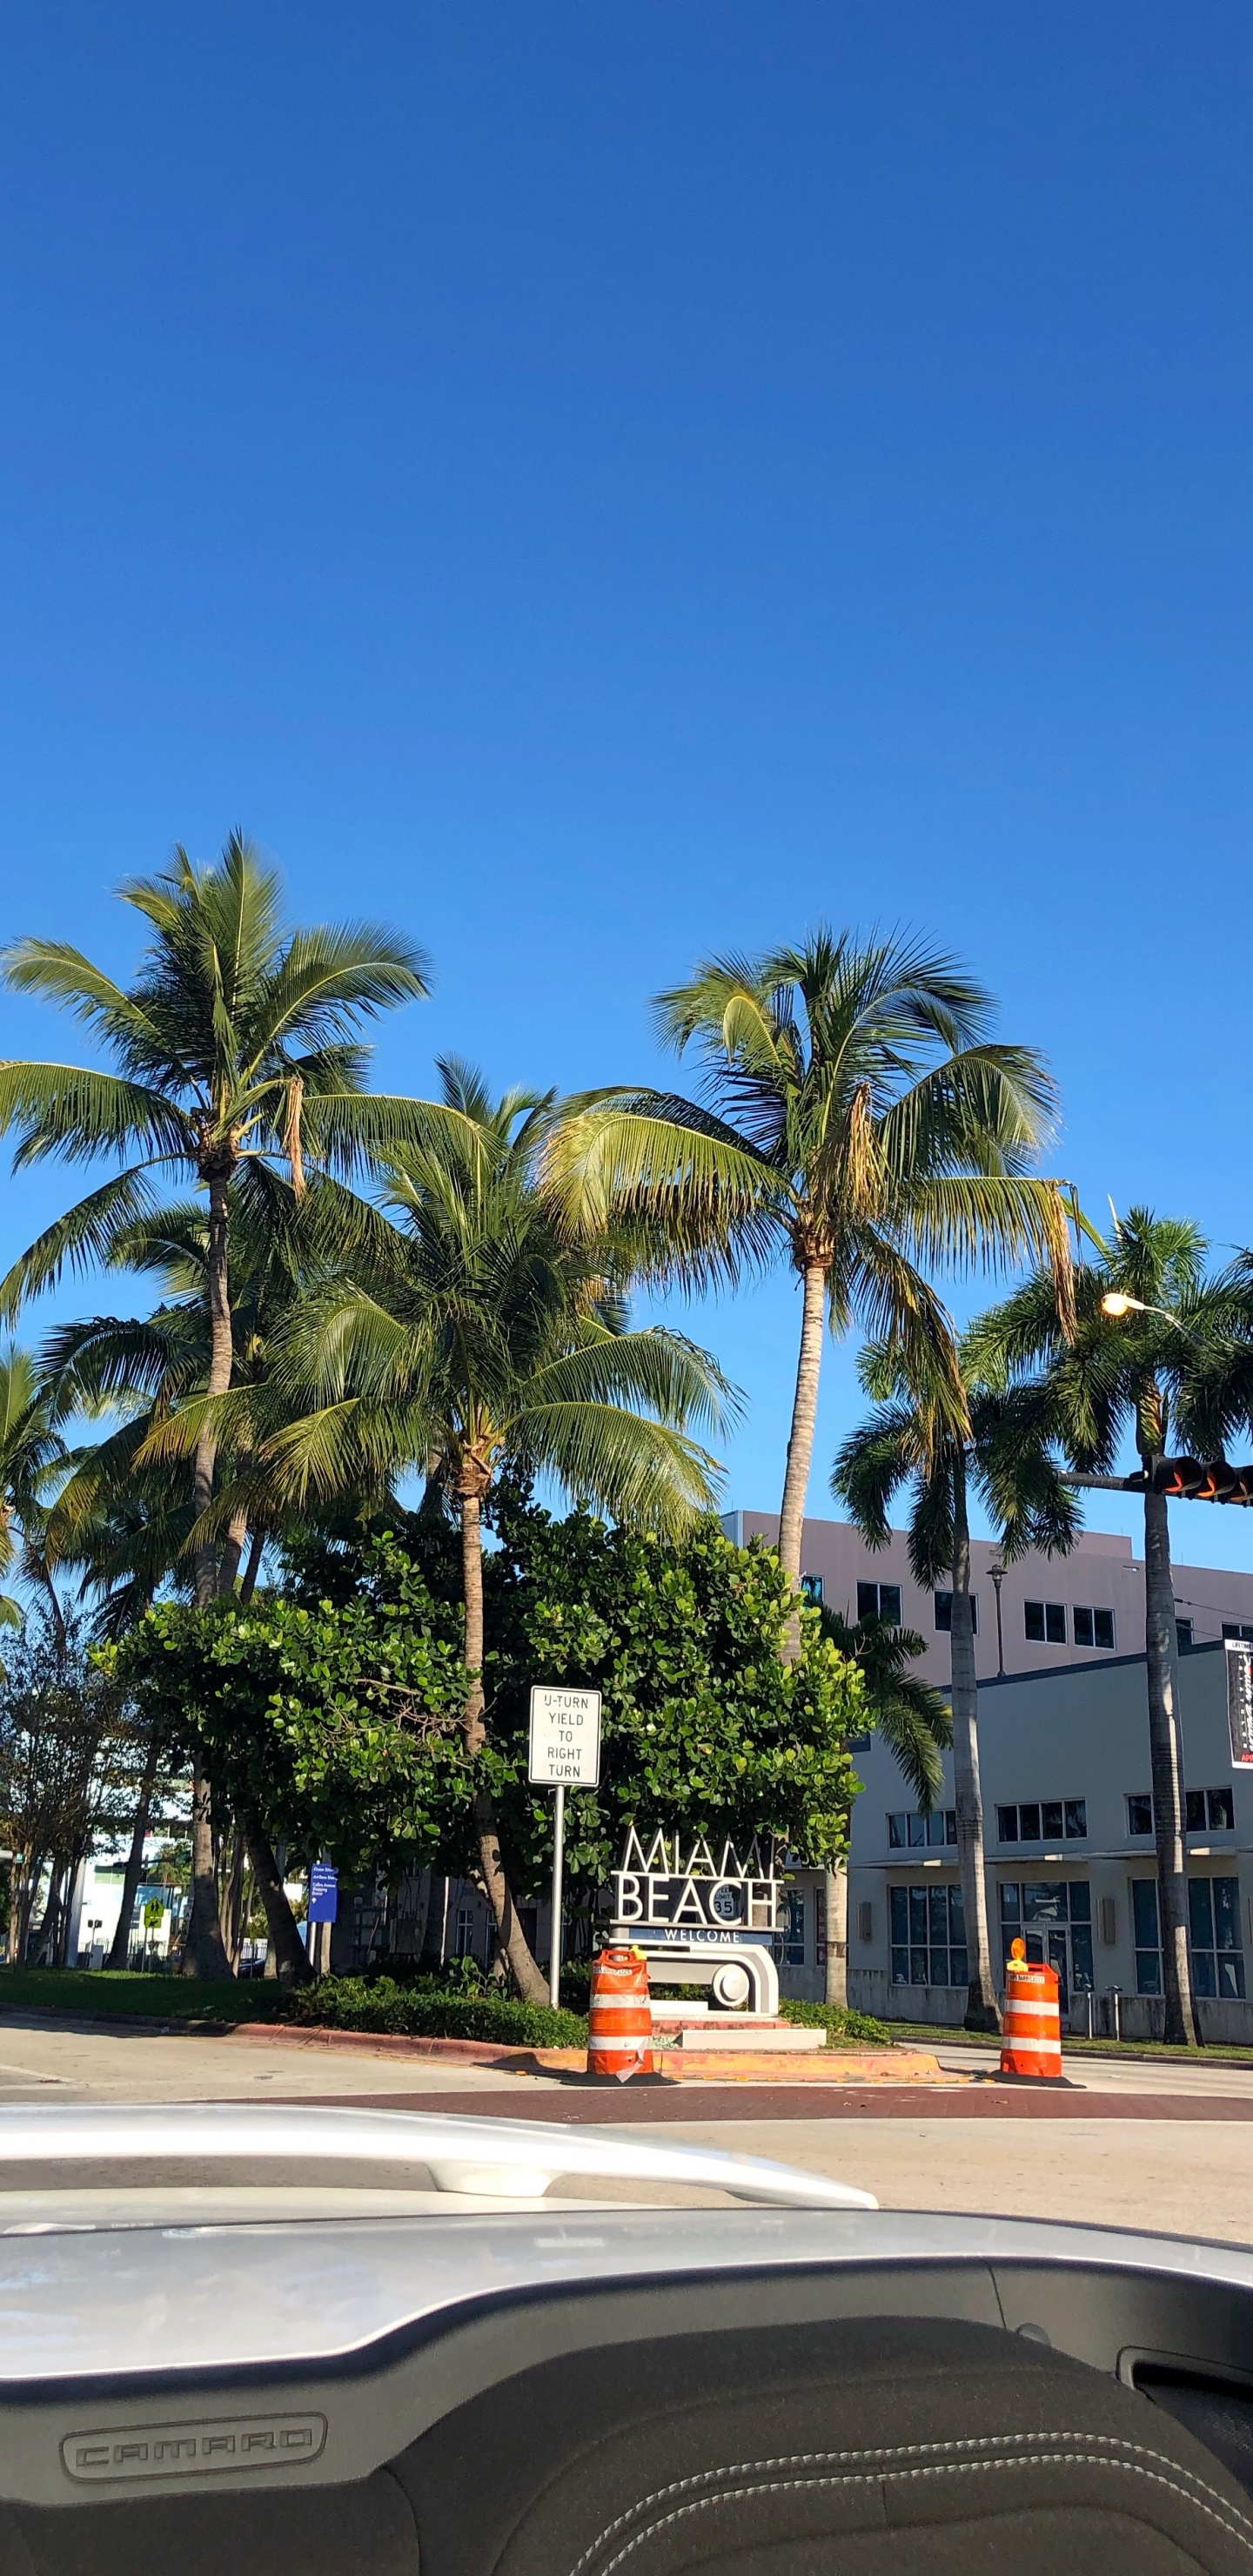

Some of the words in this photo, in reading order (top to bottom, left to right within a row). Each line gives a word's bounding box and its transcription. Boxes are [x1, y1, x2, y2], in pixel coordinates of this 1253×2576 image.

[544, 1694, 588, 1709] U-TURN
[548, 1712, 584, 1726] YIELD
[559, 1730, 573, 1742] TO
[547, 1747, 582, 1761] RIGHT
[548, 1764, 580, 1778] TURN
[622, 1826, 774, 1879] MIAMI
[618, 1874, 776, 1928] BEACH
[714, 1901, 733, 1914] 35
[664, 1929, 740, 1943] WELCOME
[76, 2429, 312, 2467] CAMARO
